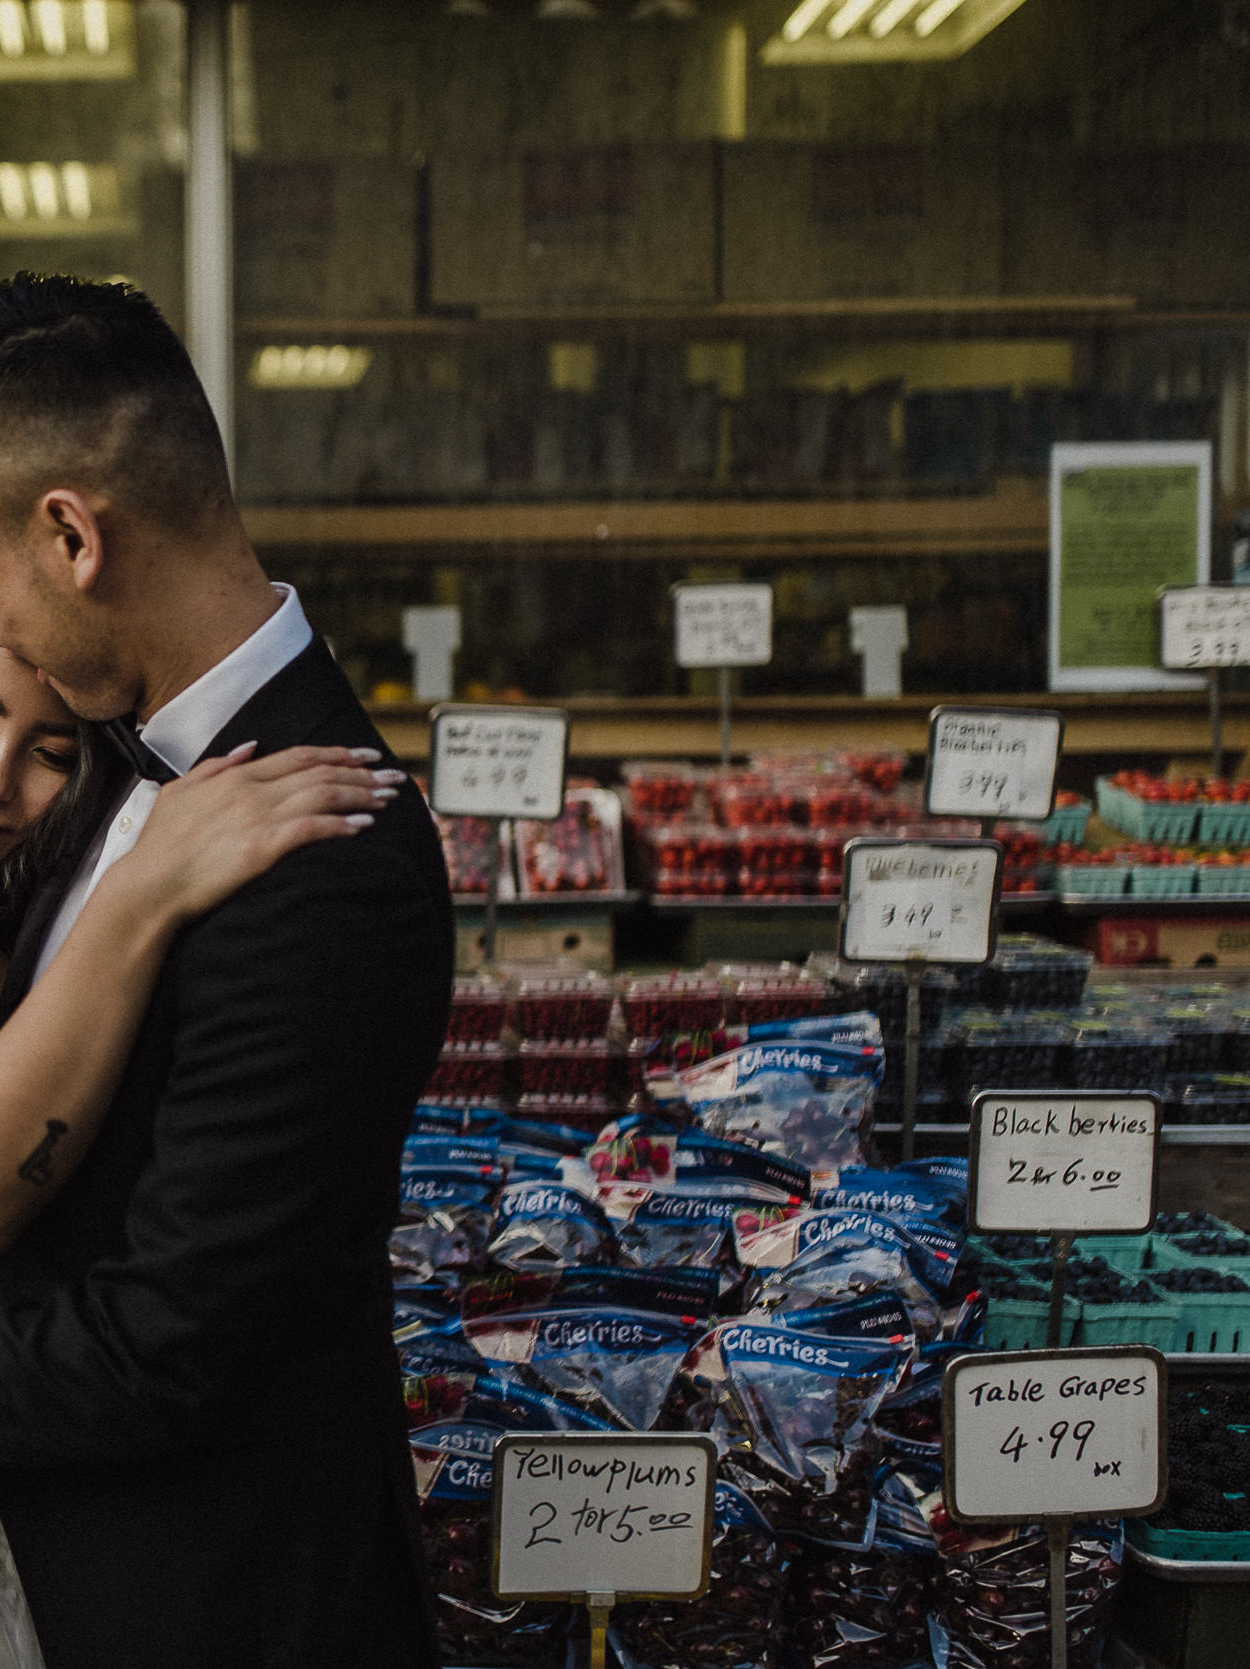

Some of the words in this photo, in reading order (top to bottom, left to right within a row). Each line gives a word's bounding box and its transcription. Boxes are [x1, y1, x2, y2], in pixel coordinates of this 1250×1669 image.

[739, 1047, 838, 1074] Cherries
[803, 1214, 912, 1249] Cherries
[543, 1318, 662, 1347] Cherries
[722, 1327, 850, 1369] Cherries
[969, 1378, 1046, 1408] Table
[1059, 1375, 1148, 1402] Grapes
[999, 1420, 1096, 1464] 4.99
